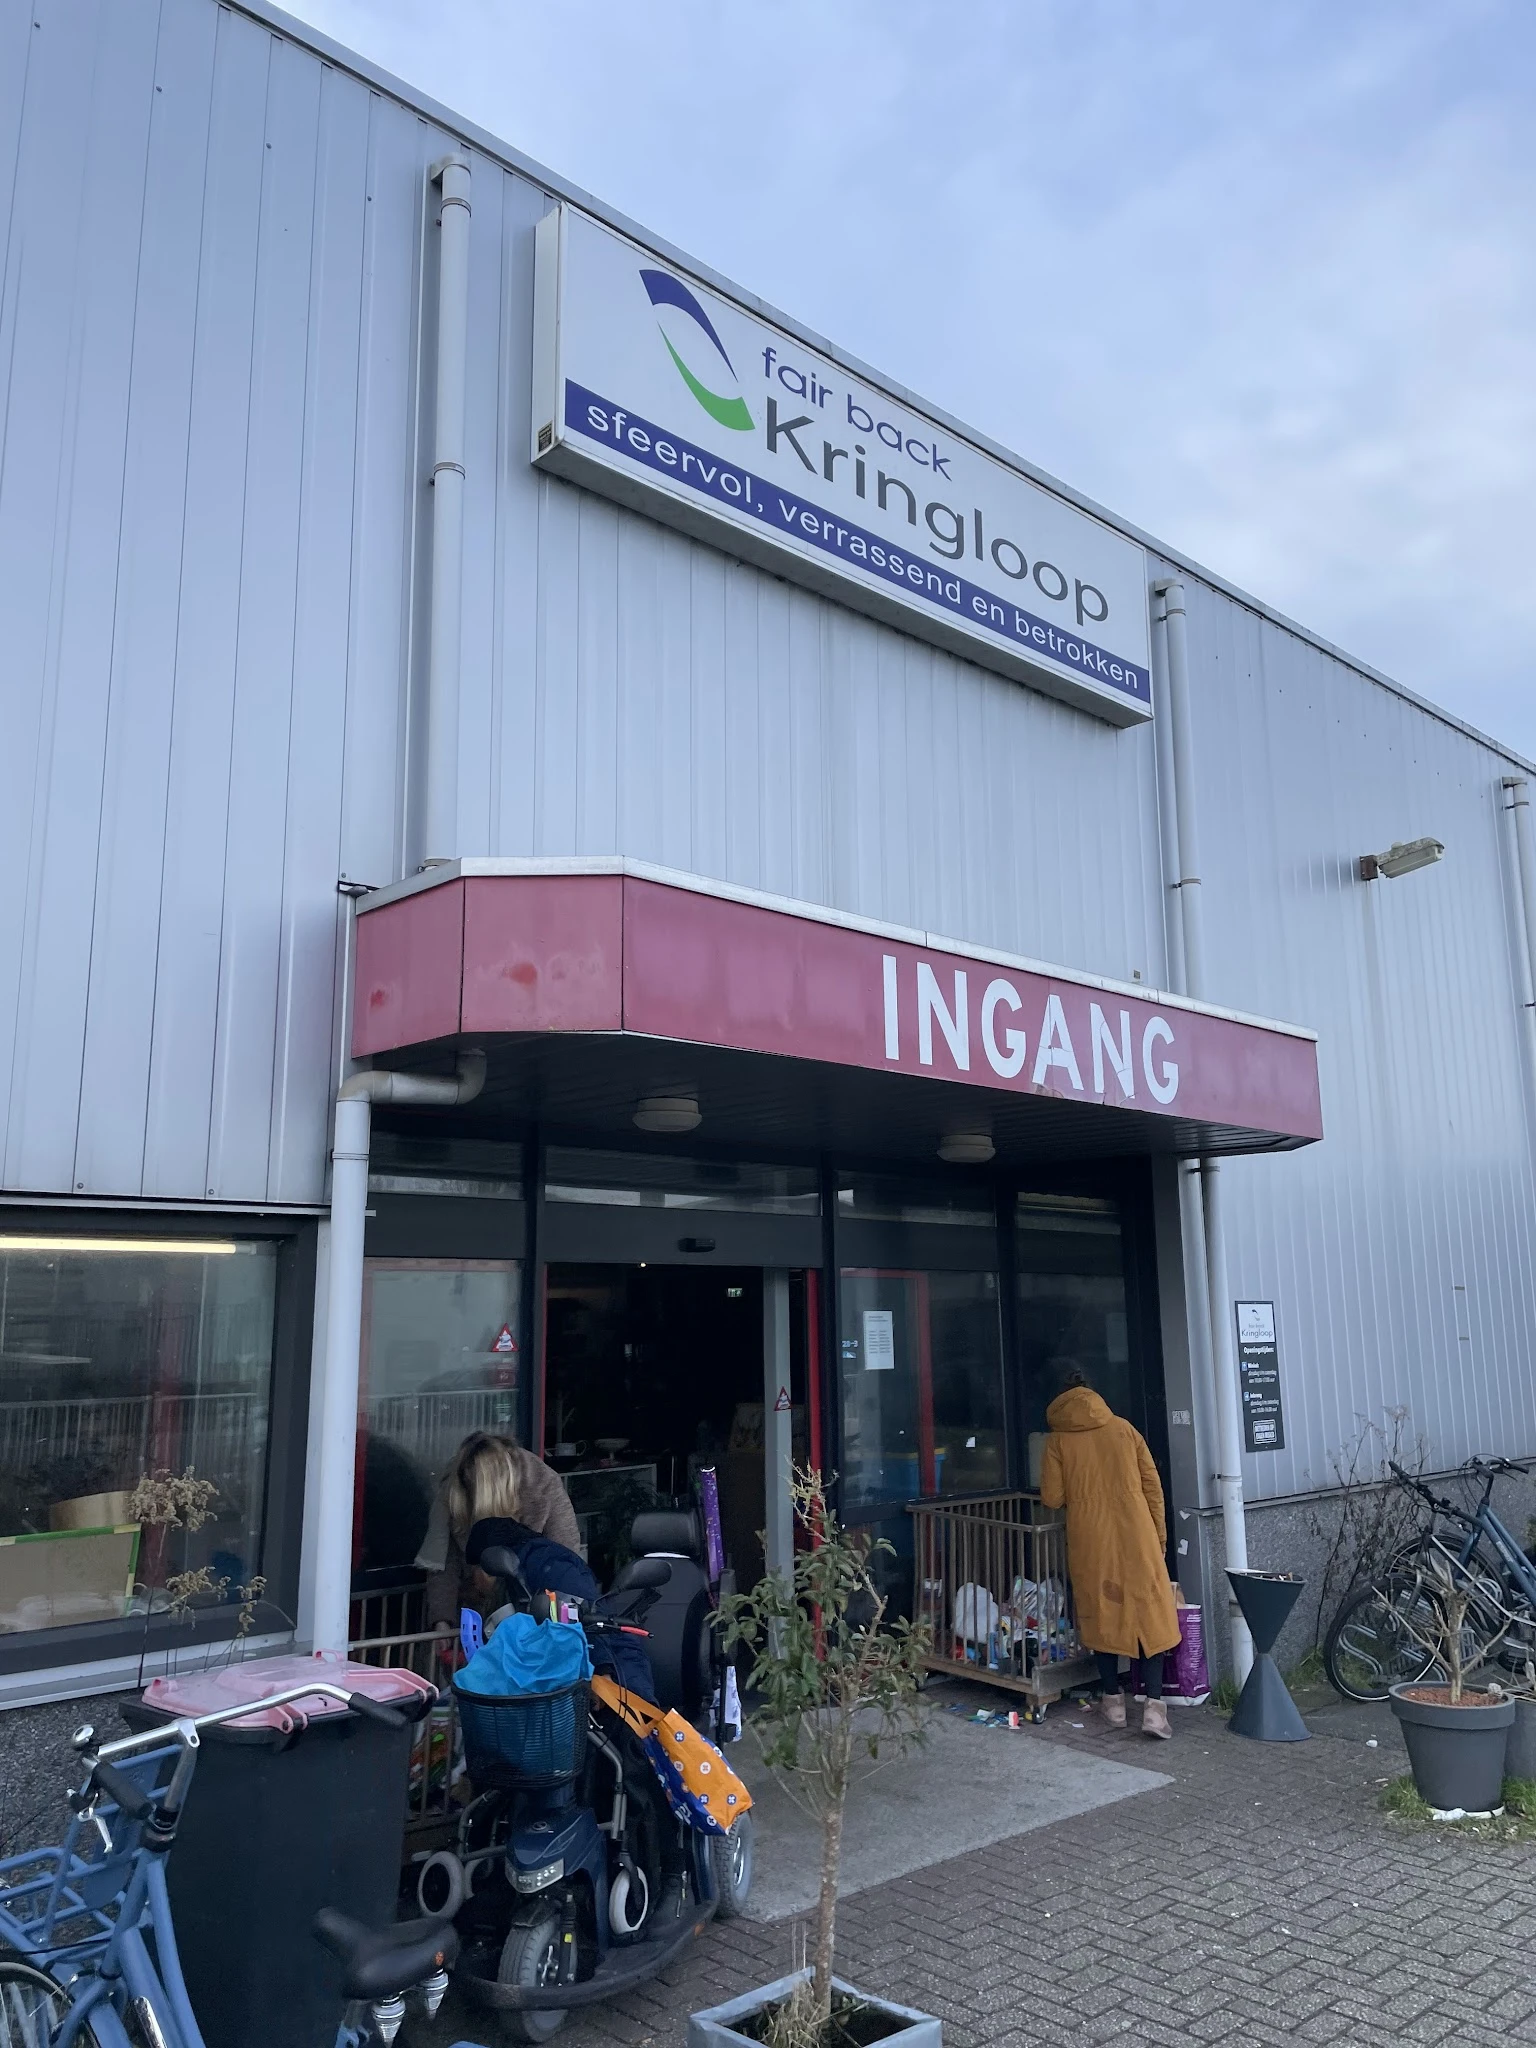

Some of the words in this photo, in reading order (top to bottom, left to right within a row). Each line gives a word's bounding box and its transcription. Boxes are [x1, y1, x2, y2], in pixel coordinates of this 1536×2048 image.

[761, 346, 834, 409] fair
[847, 393, 953, 482] back
[586, 404, 764, 513] sfeervol,
[778, 498, 961, 605] verrassend
[971, 594, 1005, 626] en
[1014, 610, 1139, 690] betrokken
[766, 395, 1109, 627] Kringloop
[882, 954, 1180, 1105] INGANG
[1241, 1329, 1274, 1339] Kringloop
